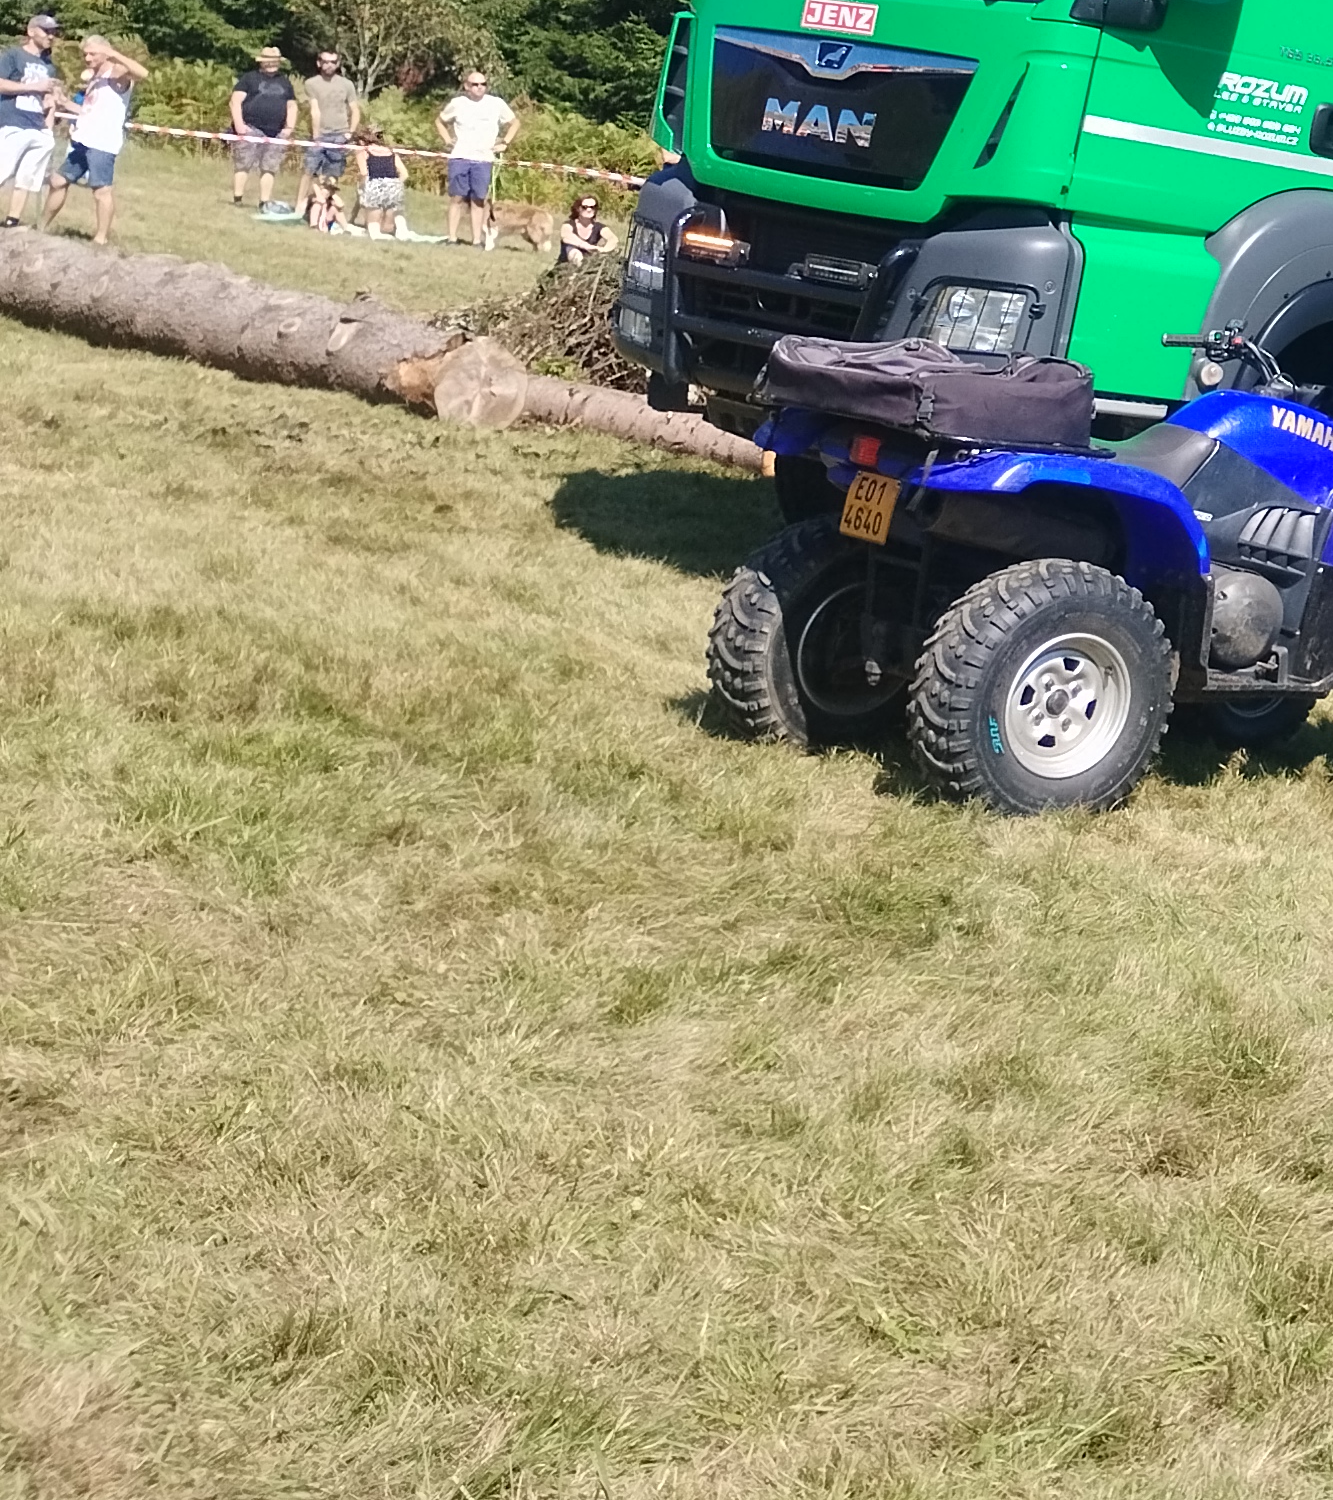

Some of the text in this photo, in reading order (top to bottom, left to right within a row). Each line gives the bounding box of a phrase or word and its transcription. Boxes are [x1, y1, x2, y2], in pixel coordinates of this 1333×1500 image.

[806, 2, 874, 30] JENZ
[1217, 71, 1309, 106] ROZUM
[761, 97, 877, 148] MAN
[854, 476, 888, 506] E01
[844, 504, 883, 536] 4640
